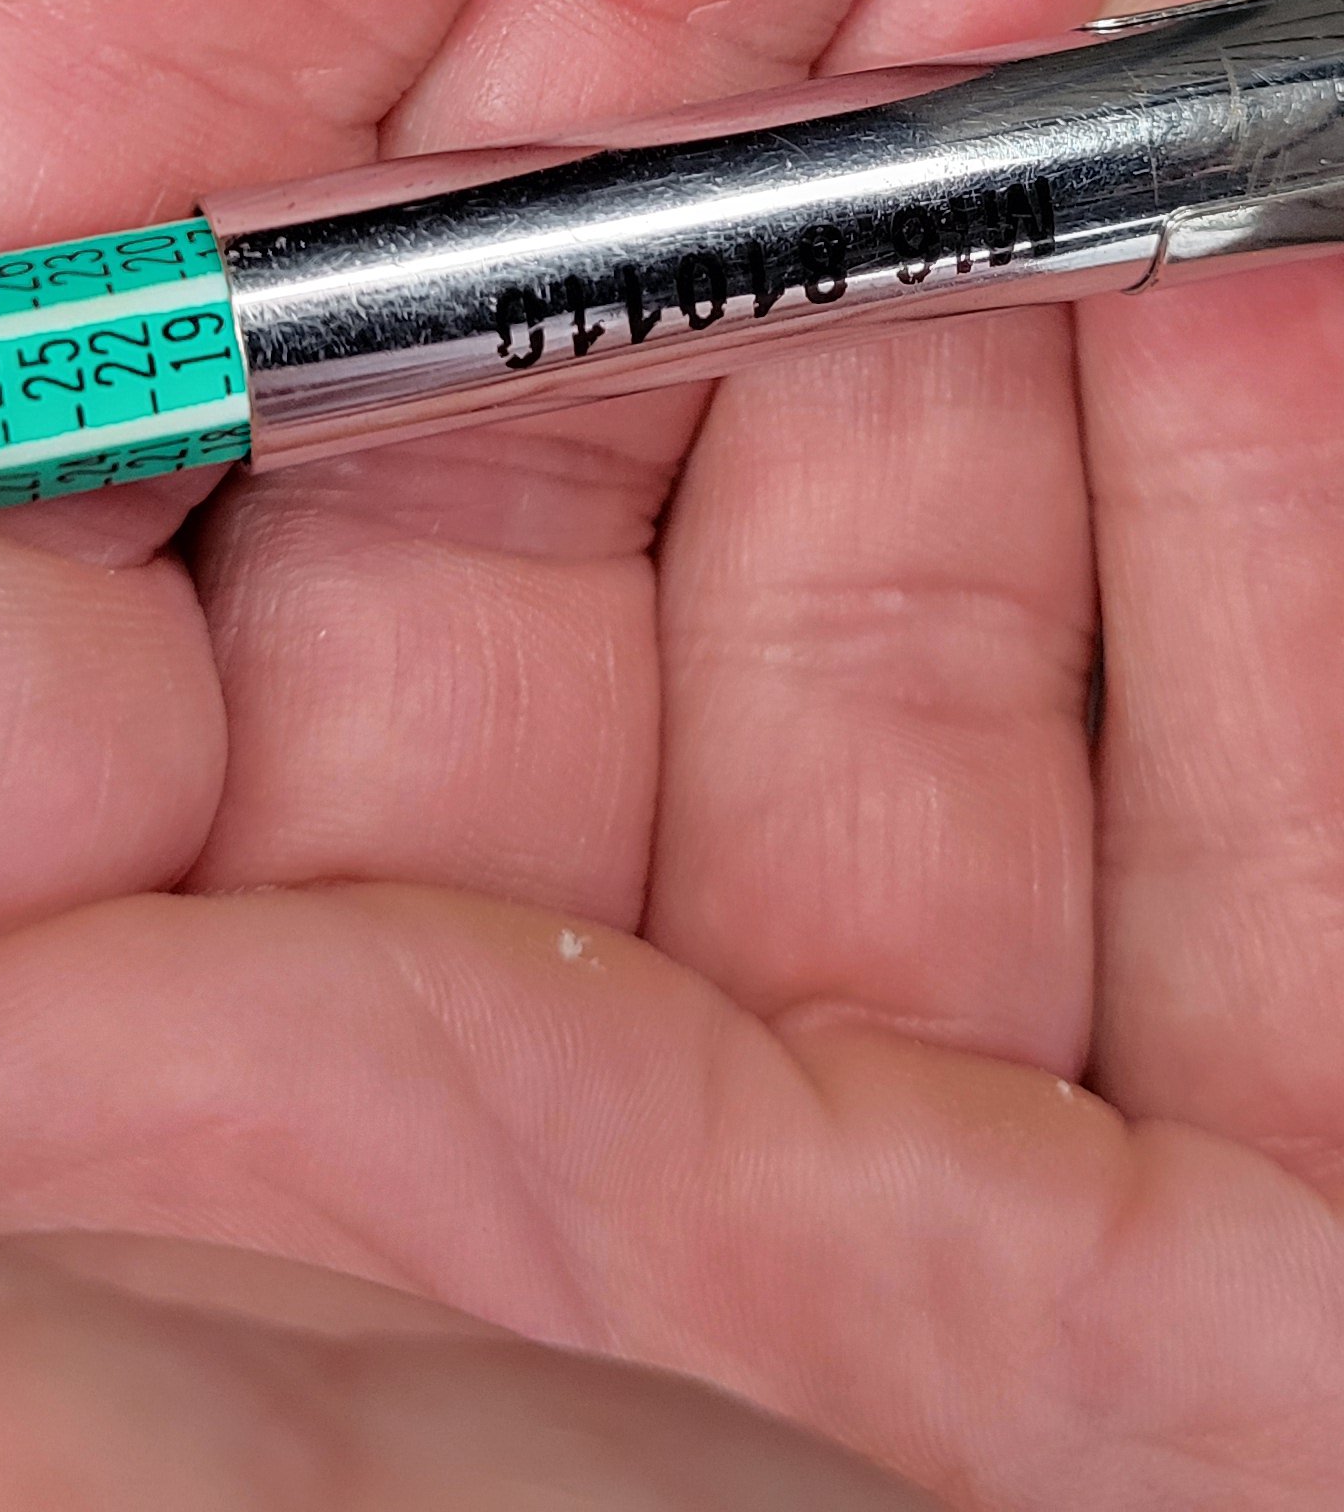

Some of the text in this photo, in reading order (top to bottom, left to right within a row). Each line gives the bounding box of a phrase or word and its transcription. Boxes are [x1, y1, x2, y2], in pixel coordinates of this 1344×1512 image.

[44, 248, 110, 286] 23
[116, 235, 183, 272] 20
[88, 321, 156, 386] 22
[162, 313, 231, 372] 19
[17, 339, 84, 400] 25
[126, 437, 190, 469] 21
